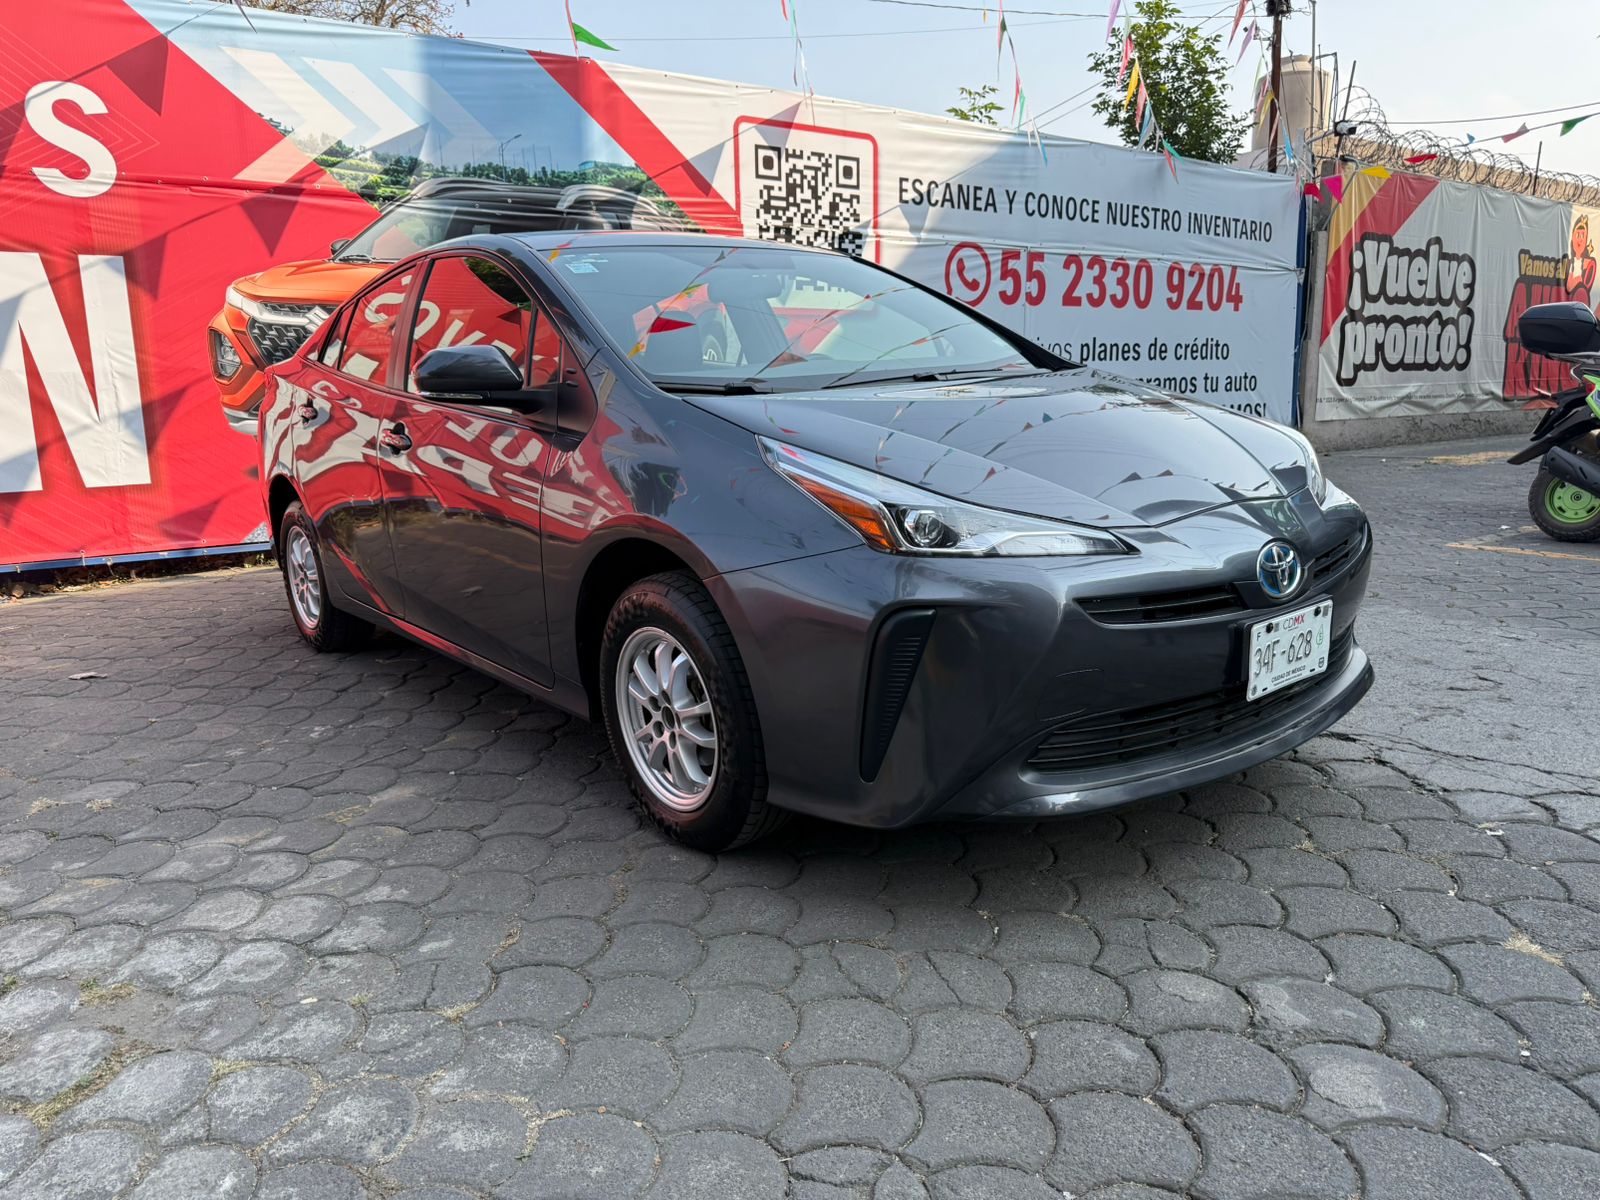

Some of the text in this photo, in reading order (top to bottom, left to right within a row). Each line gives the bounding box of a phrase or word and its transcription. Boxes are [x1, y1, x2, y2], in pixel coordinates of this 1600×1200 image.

[24, 80, 118, 198] S
[898, 177, 1272, 243] ESCANEA Y CONOCE NUESTRO INVENTARIO
[998, 248, 1243, 312] 55 2330 9204
[1348, 239, 1473, 311] ¡Vuelve
[1520, 252, 1555, 278] Vamos
[1080, 337, 1141, 362] planes
[1147, 338, 1168, 360] de
[1174, 338, 1230, 360] crédito
[1340, 312, 1472, 379] pronto!
[1203, 374, 1219, 393] tu
[1224, 371, 1258, 392] auto
[1283, 614, 1305, 629] CDMX
[1254, 629, 1313, 678] 34F-628
